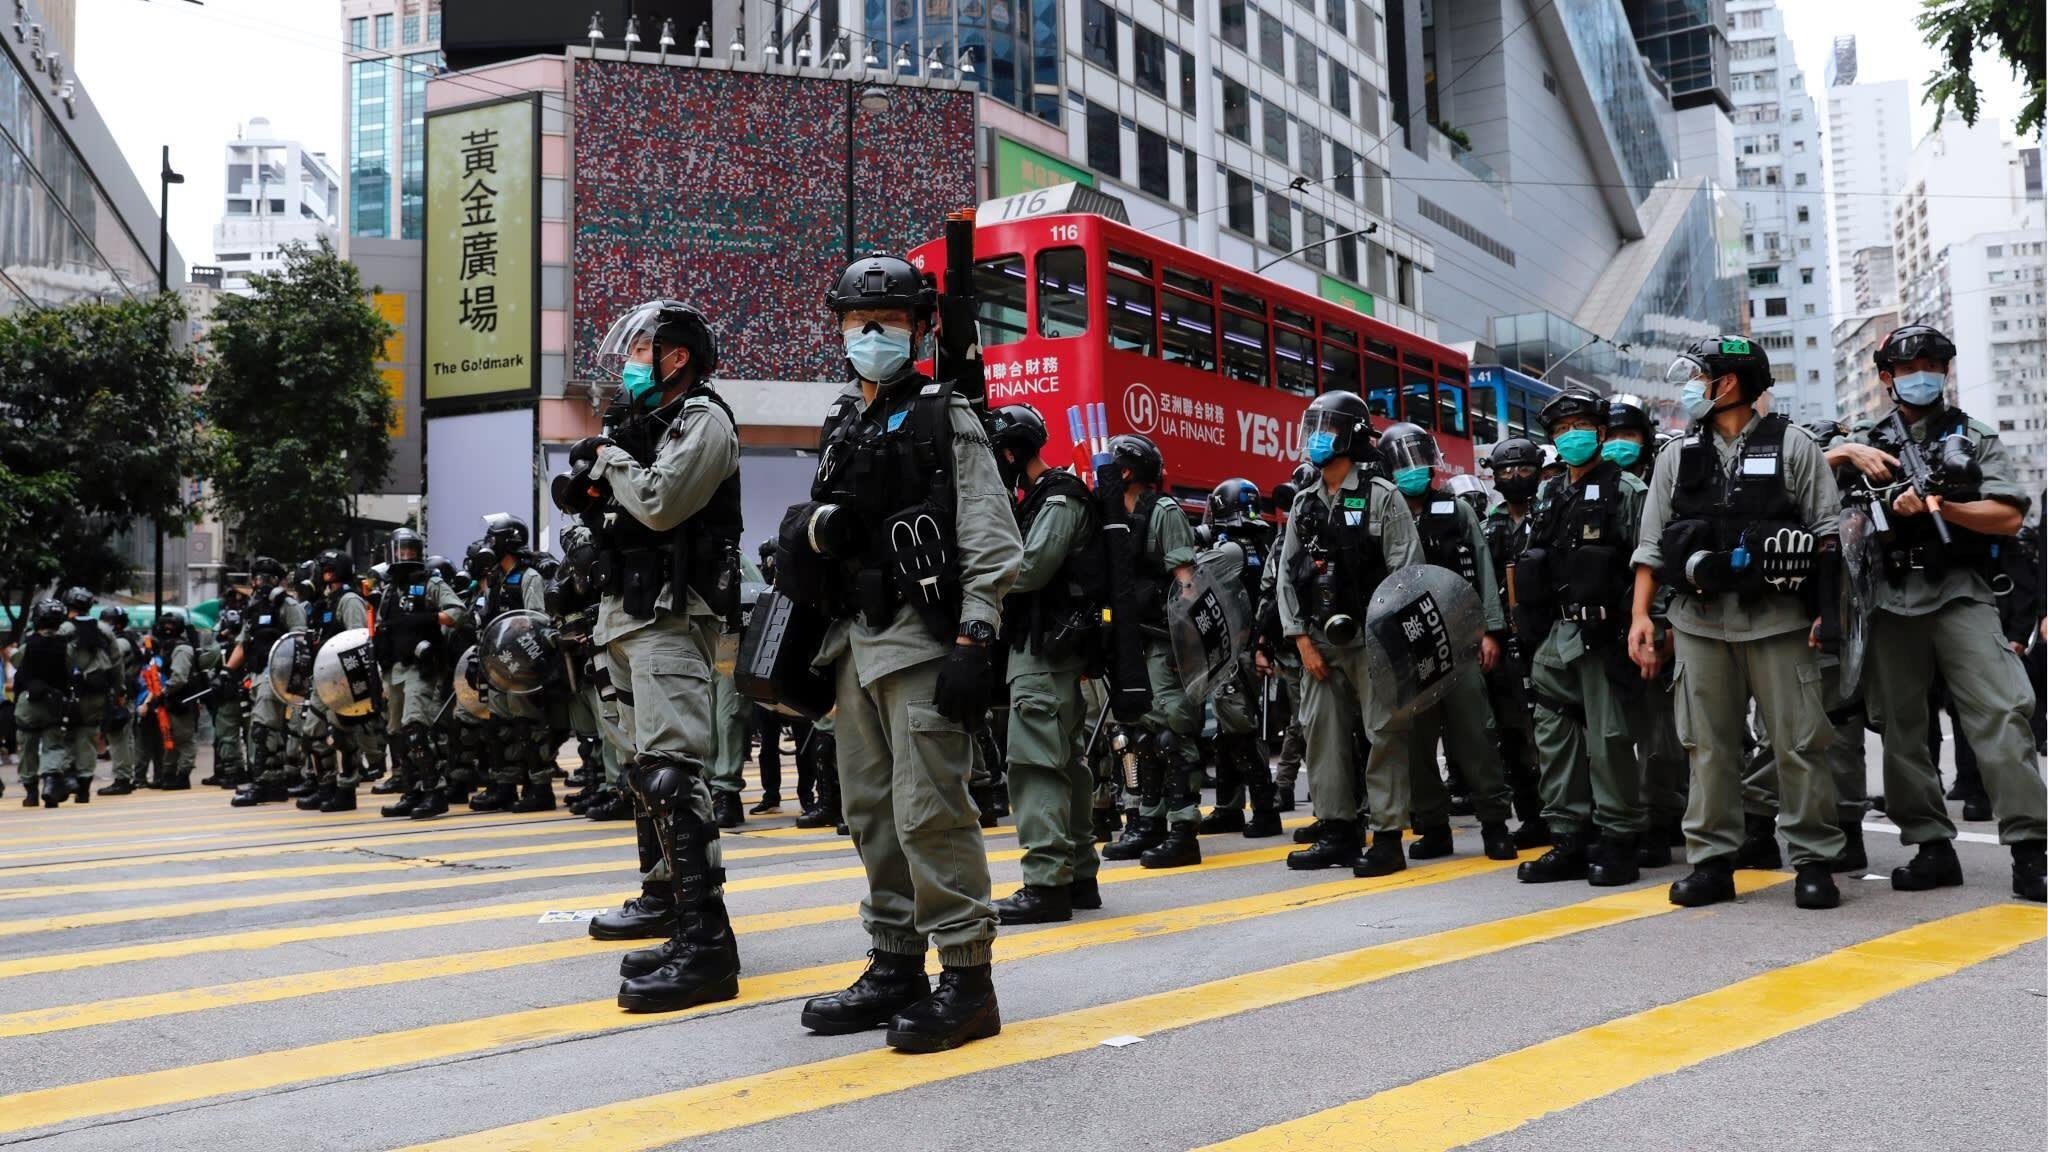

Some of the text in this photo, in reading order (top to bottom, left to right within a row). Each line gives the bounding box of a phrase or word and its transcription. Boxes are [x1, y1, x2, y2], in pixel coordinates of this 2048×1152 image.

[1001, 190, 1049, 220] 116
[459, 128, 499, 333] 黃金廣場
[1050, 224, 1079, 241] 116
[433, 354, 524, 375] The Goldmark
[1478, 371, 1491, 382] 41
[989, 376, 1060, 400] FINANCE
[1160, 392, 1224, 425] 亞洲聯合財務
[1161, 416, 1226, 446] UA FINANCE
[1419, 597, 1451, 672] POLICE
